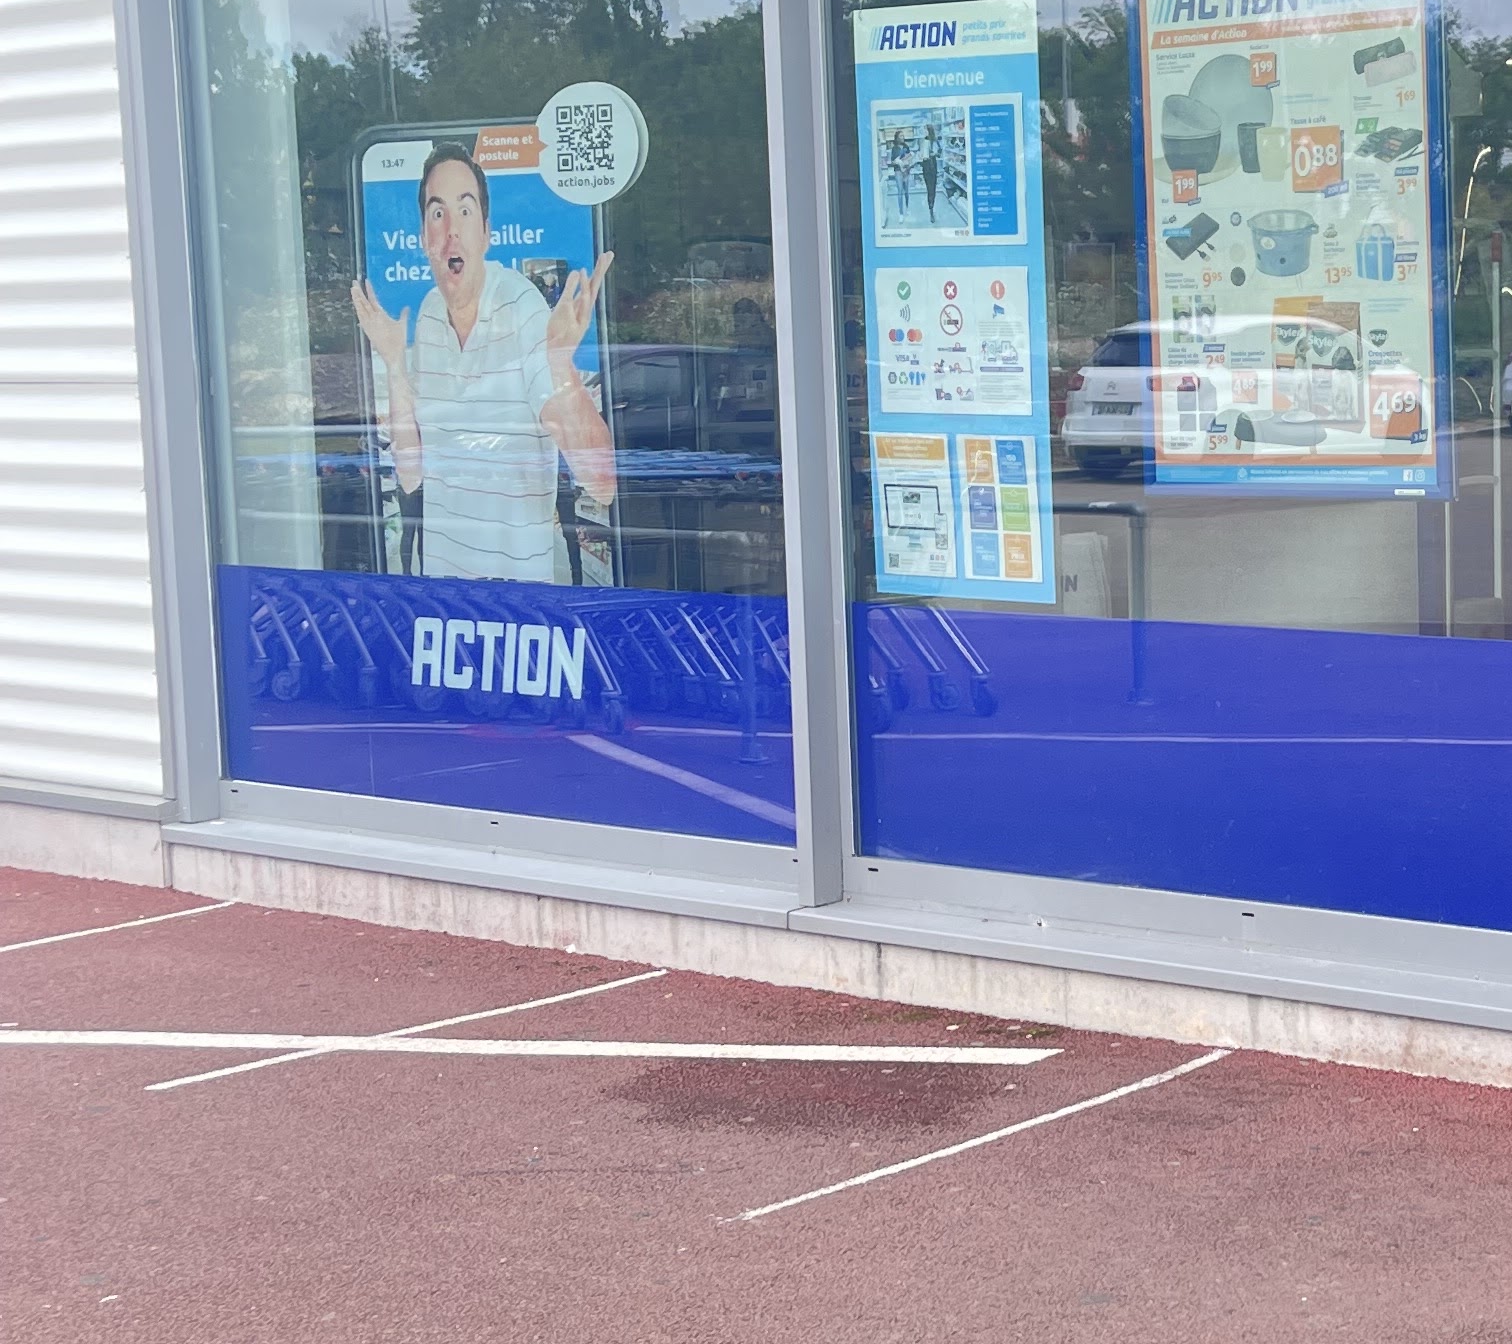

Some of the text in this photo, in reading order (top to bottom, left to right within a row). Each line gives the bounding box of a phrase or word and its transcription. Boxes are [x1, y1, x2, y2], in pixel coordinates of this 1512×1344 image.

[879, 20, 957, 51] ACTION
[1160, 35, 1171, 45] La
[1173, 32, 1209, 44] semaine
[903, 69, 984, 89] bienvenue
[482, 134, 533, 146] Scanne et
[479, 150, 519, 162] postule
[381, 158, 404, 168] 13:47
[558, 176, 615, 188] action.jobs
[385, 262, 431, 281] chez
[411, 616, 586, 699] ACTION
